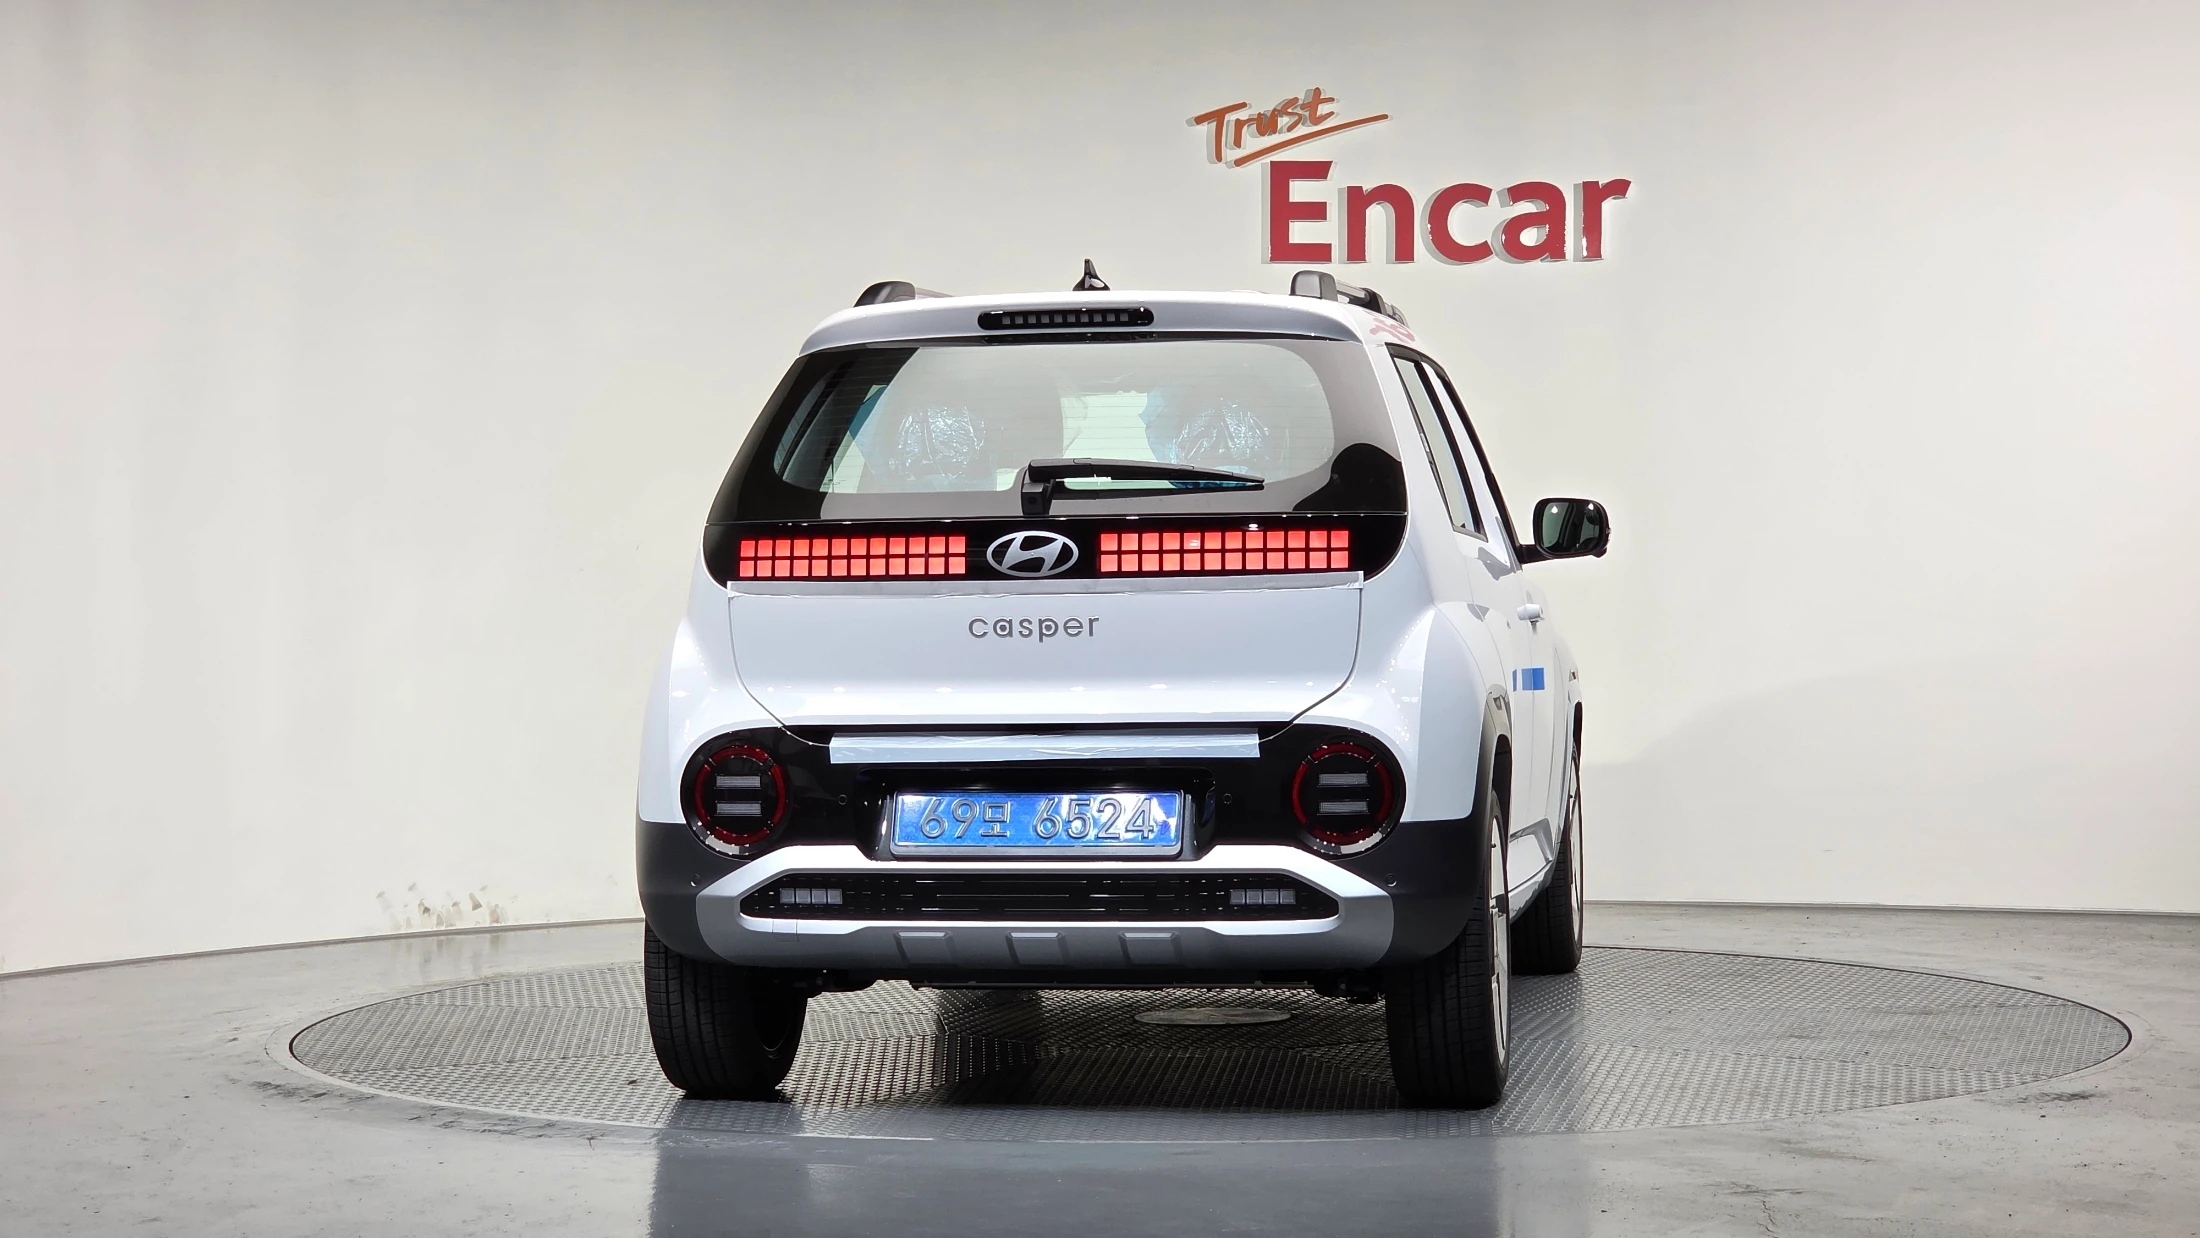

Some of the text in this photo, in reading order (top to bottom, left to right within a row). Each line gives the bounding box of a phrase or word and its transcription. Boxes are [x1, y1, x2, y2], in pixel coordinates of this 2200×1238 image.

[1194, 87, 1336, 162] Trust
[1267, 160, 1632, 263] Encar
[968, 616, 1100, 643] casper
[920, 797, 1010, 839] 69모
[1034, 797, 1154, 839] 6524
